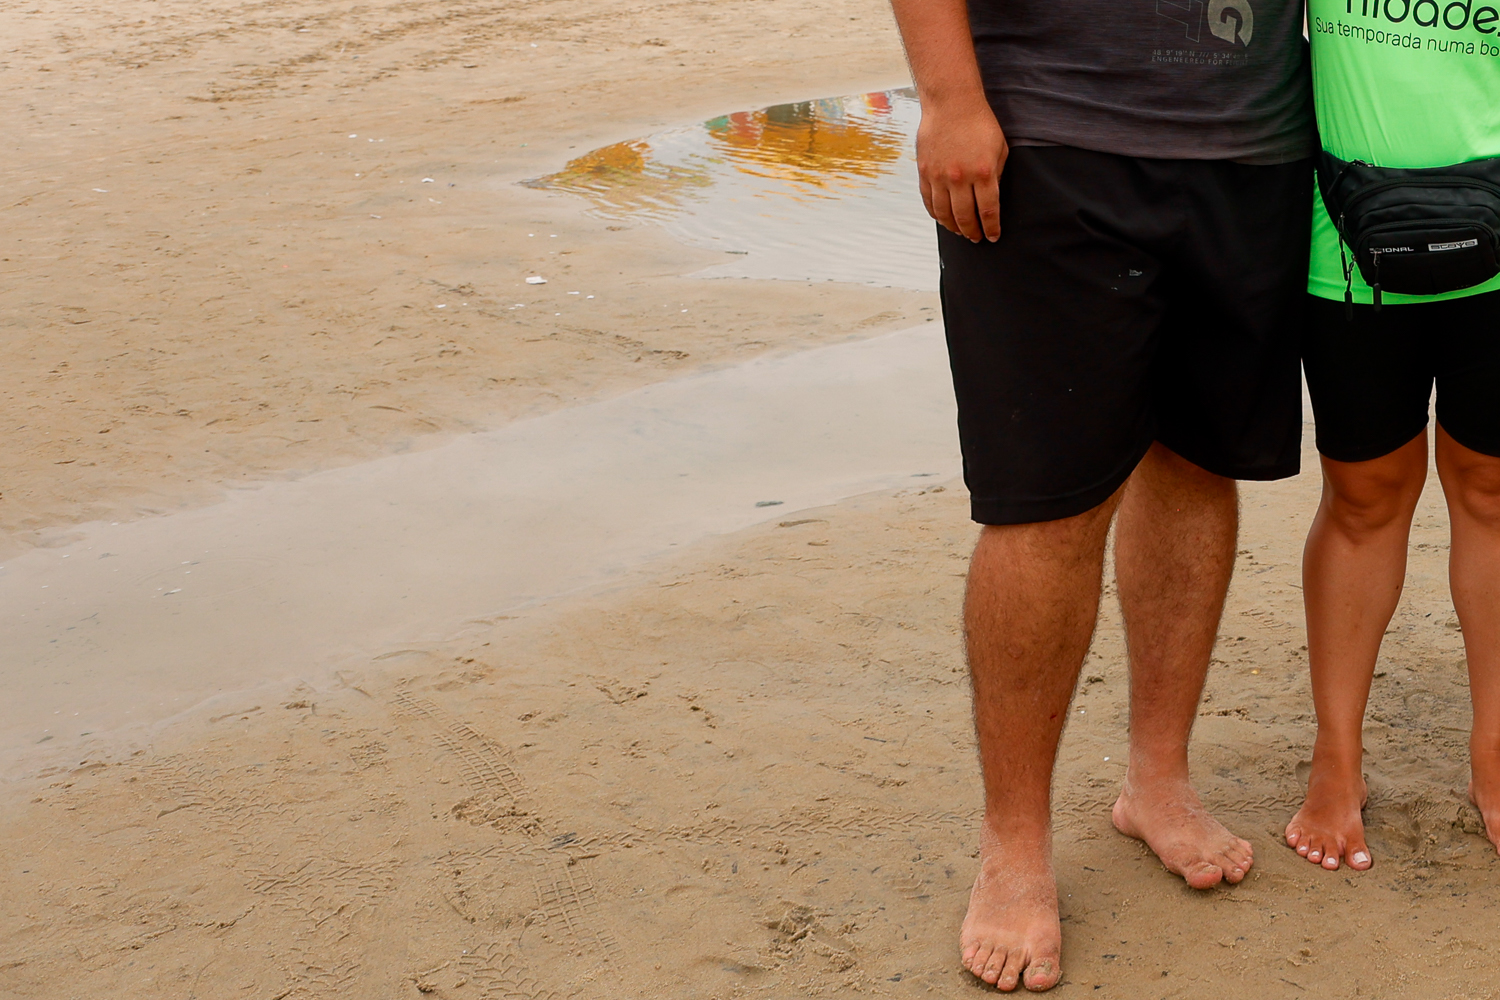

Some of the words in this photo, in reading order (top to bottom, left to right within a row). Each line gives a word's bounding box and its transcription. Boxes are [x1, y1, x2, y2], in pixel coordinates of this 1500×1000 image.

[1315, 17, 1335, 34] Sua
[1337, 19, 1422, 50] temporada
[1427, 37, 1476, 56] numa
